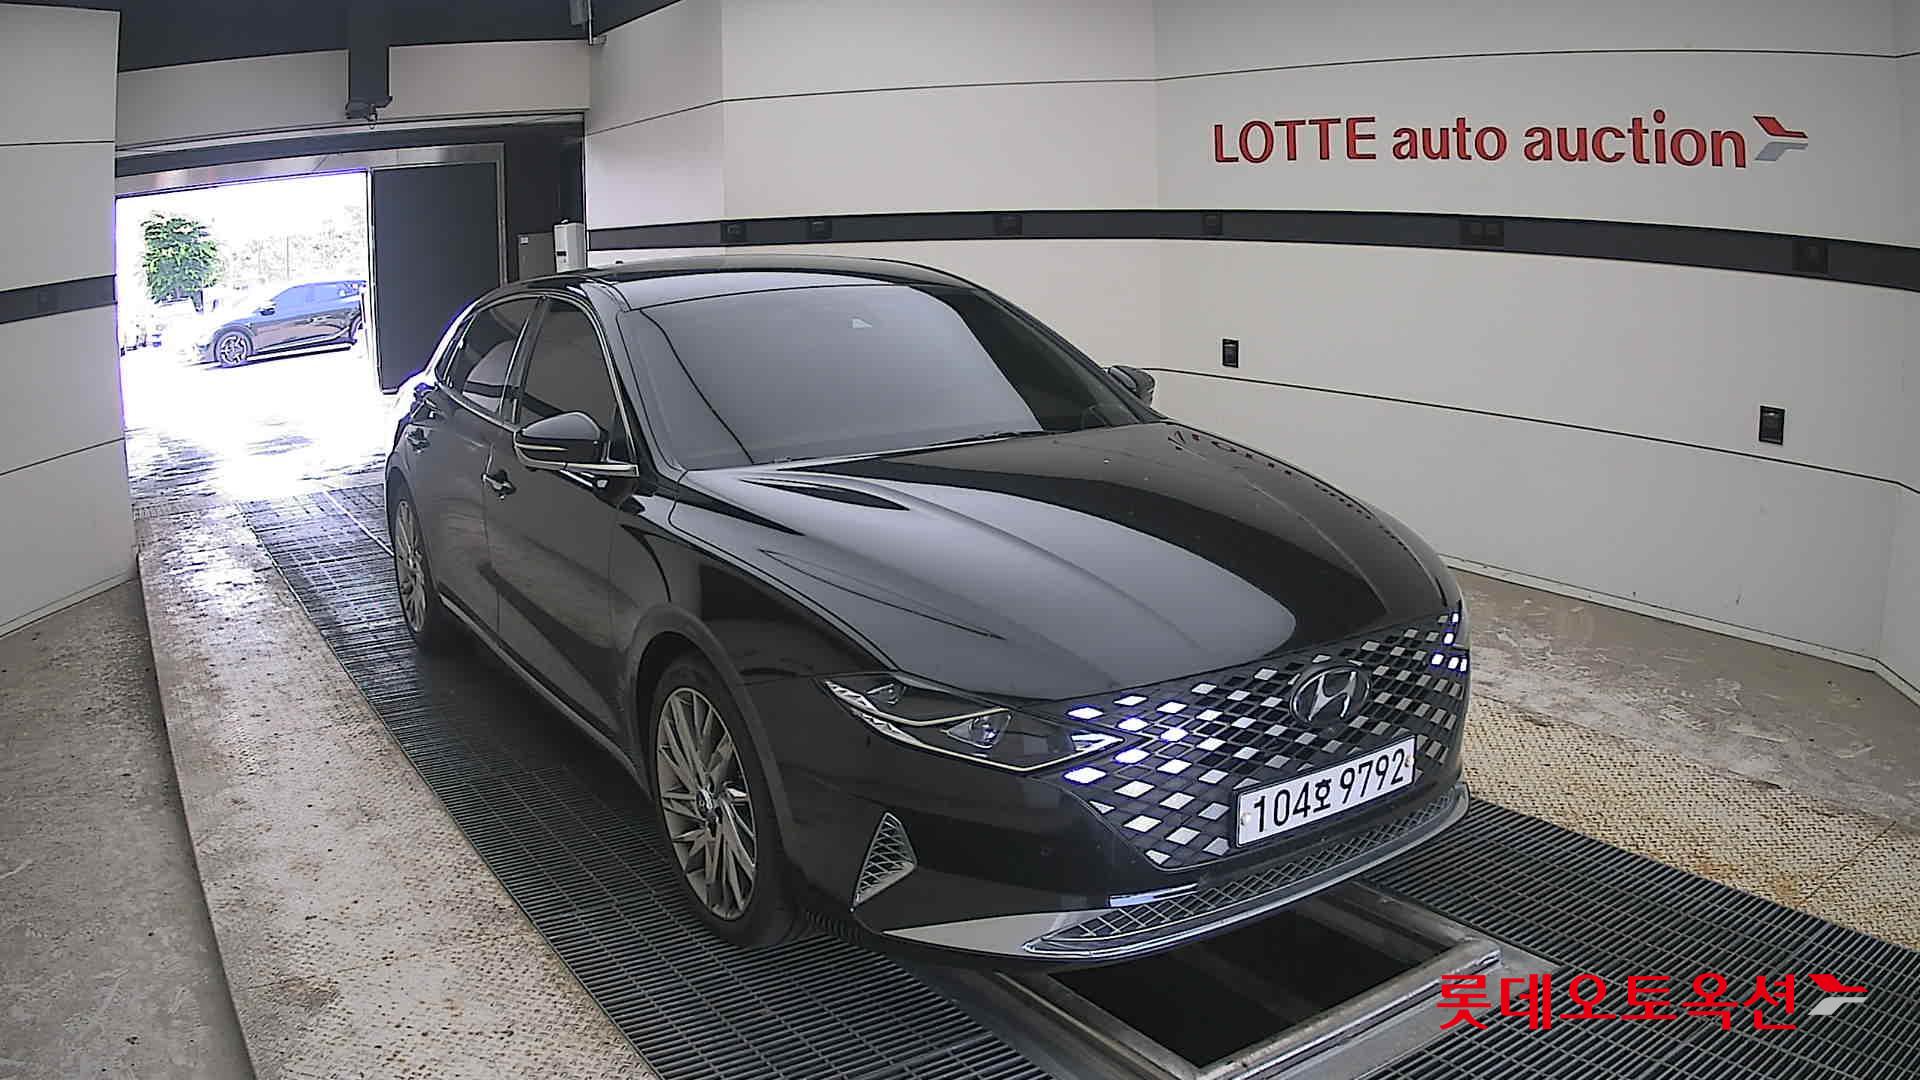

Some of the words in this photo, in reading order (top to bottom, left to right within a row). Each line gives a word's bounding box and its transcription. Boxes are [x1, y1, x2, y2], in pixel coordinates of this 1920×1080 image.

[1213, 116, 1377, 163] LOTTE
[1391, 116, 1508, 161] auto
[1523, 109, 1747, 168] auction
[1253, 778, 1332, 833] 104호
[1339, 748, 1405, 804] 9792
